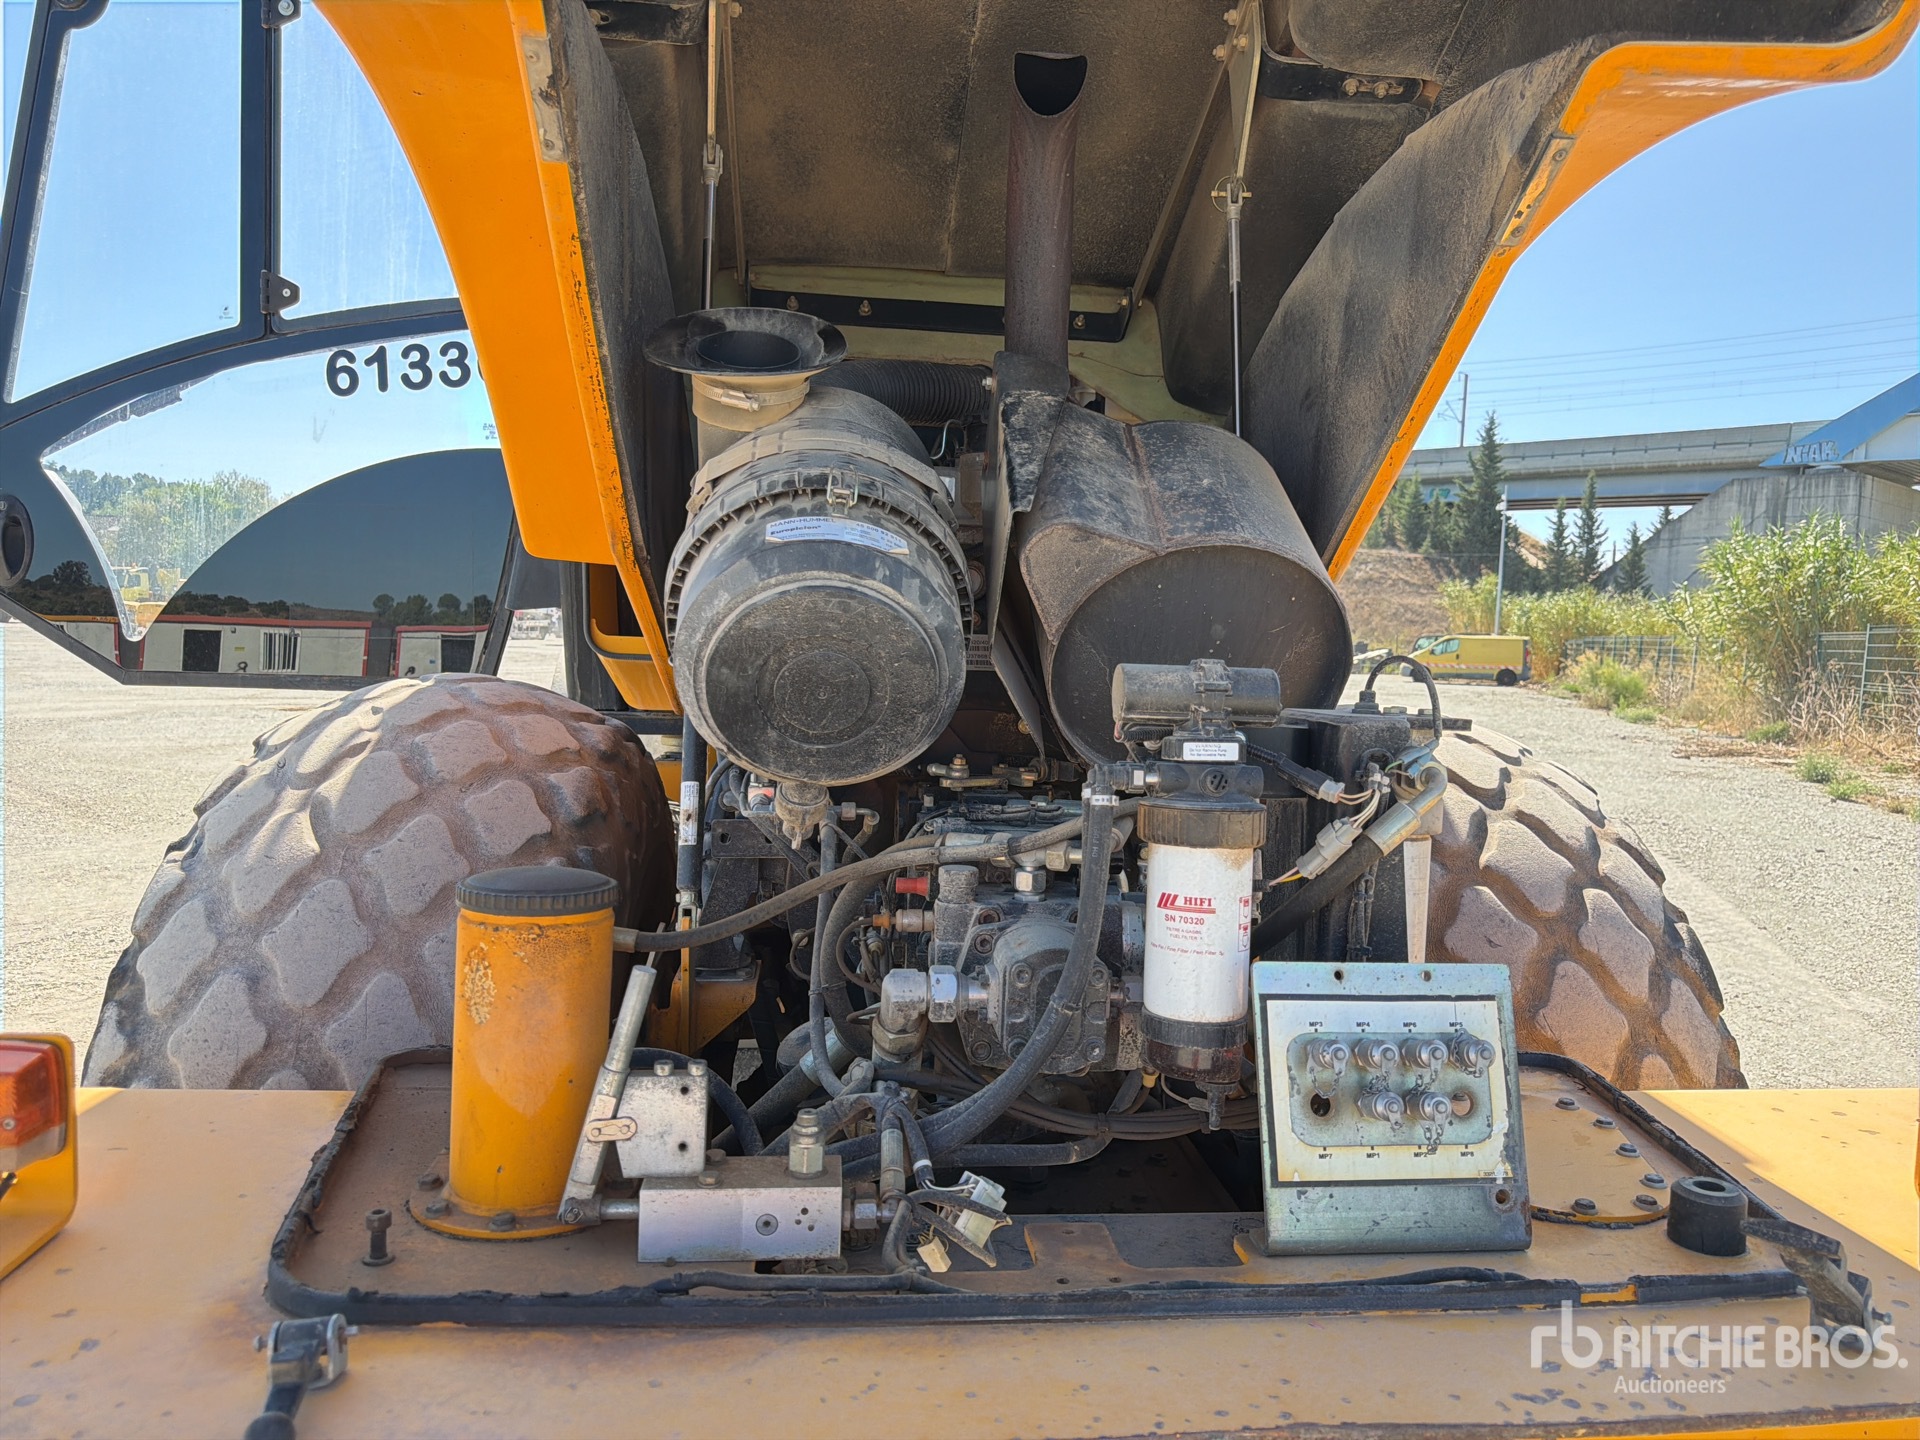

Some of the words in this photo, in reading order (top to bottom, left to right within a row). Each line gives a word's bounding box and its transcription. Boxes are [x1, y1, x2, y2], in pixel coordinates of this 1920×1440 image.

[326, 341, 485, 397] 6133
[1183, 896, 1212, 907] HIFI
[1164, 913, 1176, 922] SN
[1178, 915, 1205, 926] 70320
